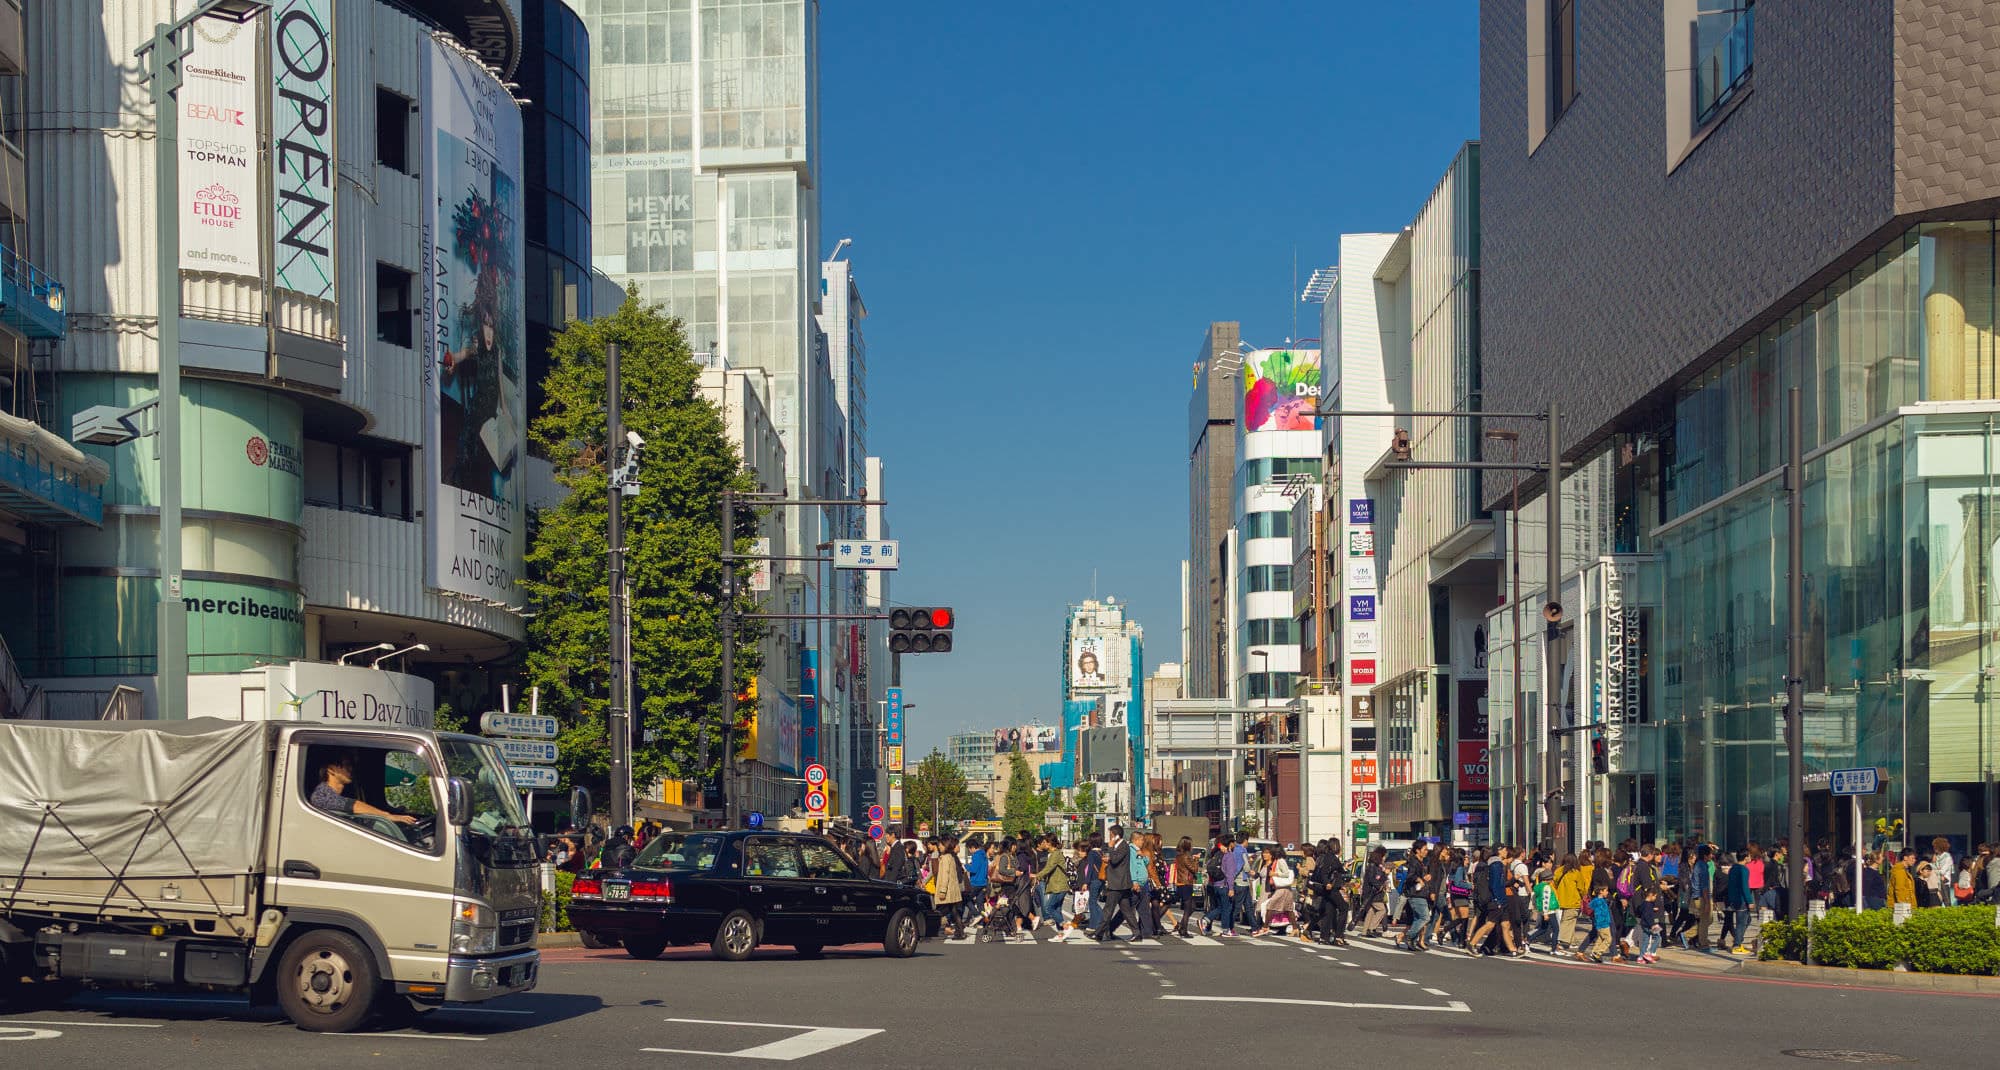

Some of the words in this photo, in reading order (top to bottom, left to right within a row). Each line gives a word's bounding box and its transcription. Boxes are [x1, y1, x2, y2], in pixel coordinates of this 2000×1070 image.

[185, 64, 247, 82] CosmeKitchen
[276, 9, 328, 258] OPEN
[187, 138, 247, 155] TOPSHOP
[187, 150, 247, 168] TOPMAN
[193, 201, 242, 220] ETUDE
[627, 194, 691, 214] HEYK
[201, 218, 235, 229] HOUSE
[631, 228, 688, 248] HAIR
[187, 247, 208, 260] and
[469, 528, 505, 561] THINK
[840, 544, 893, 557] 神宮前
[451, 553, 482, 581] AND
[857, 557, 875, 565] Jingu
[316, 689, 357, 721] The
[362, 693, 403, 727] Dayz
[1607, 643, 1624, 756] AMERICAN
[809, 769, 823, 781] 50
